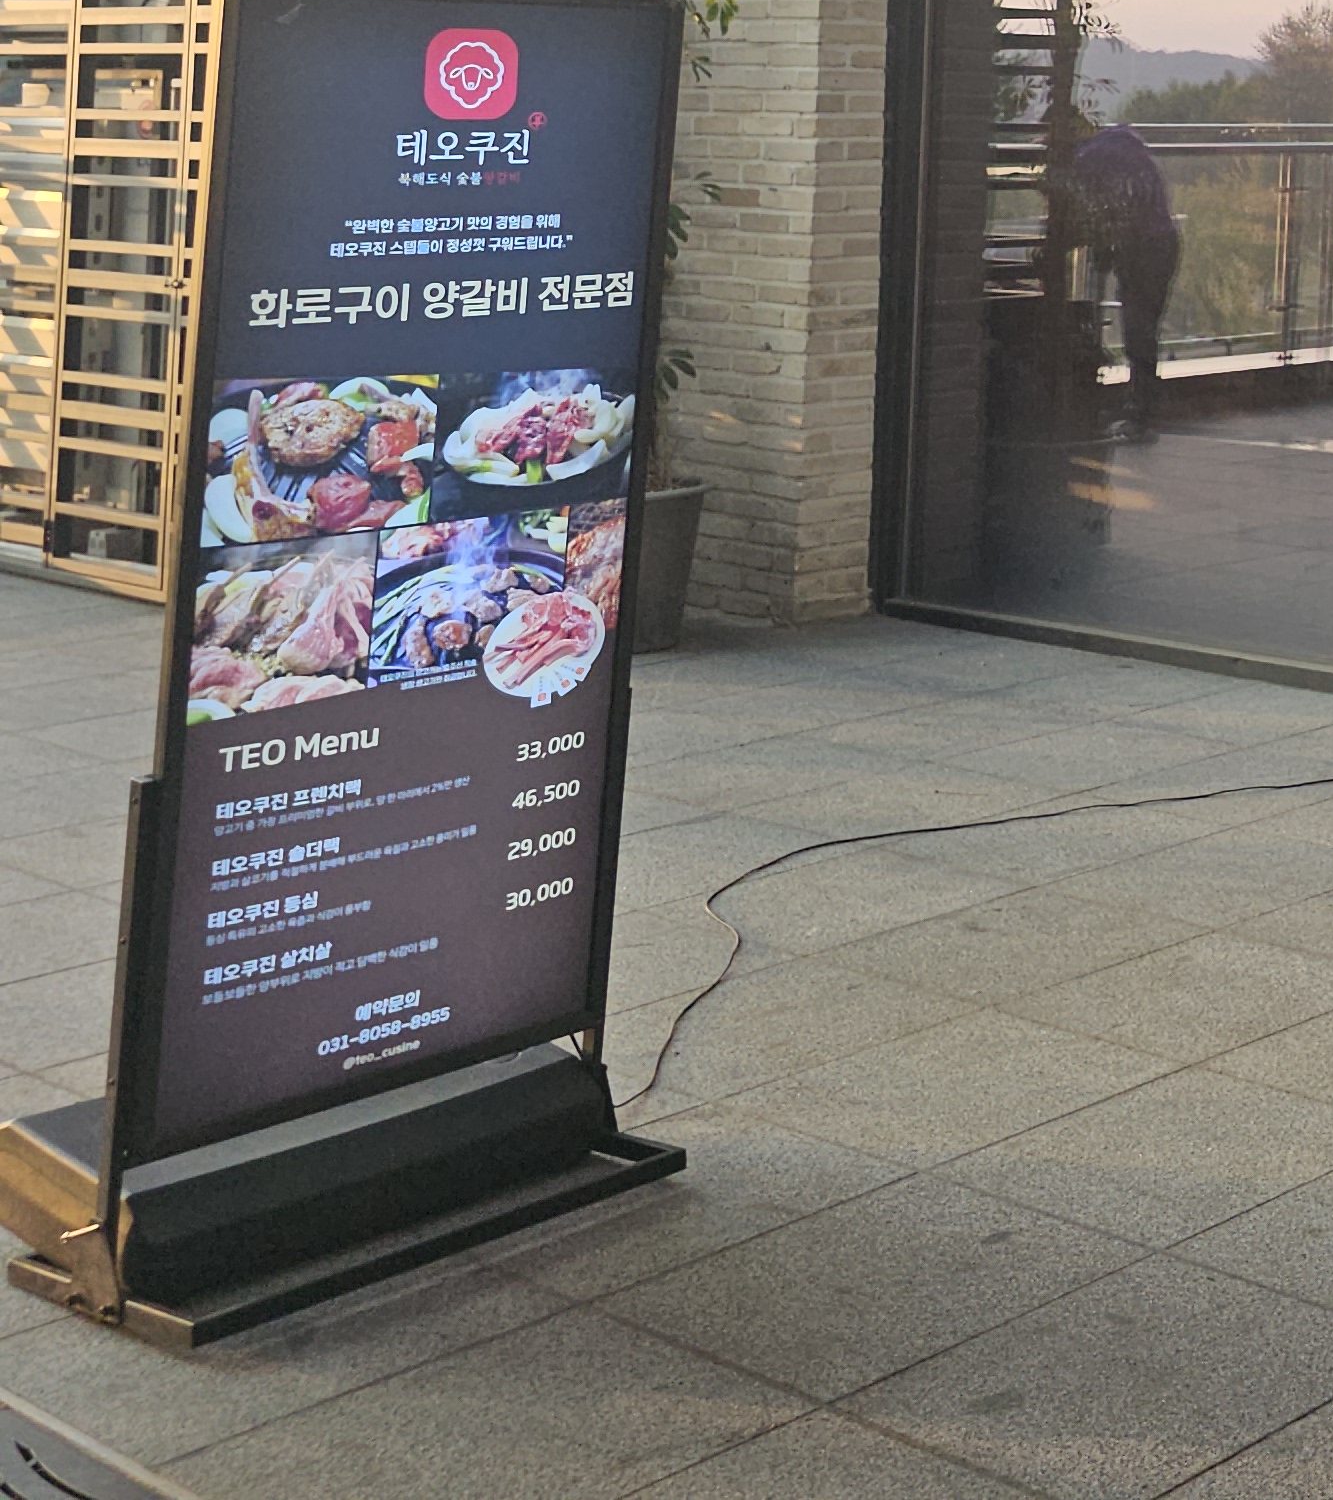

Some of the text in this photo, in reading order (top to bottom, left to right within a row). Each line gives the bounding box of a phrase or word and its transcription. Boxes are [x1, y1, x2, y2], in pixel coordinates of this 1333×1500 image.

[396, 128, 530, 166] 테오쿠진
[467, 215, 492, 230] 맛의
[536, 213, 561, 229] 위해
[330, 241, 386, 258] 테오쿠진
[446, 237, 485, 253] 정성껏
[248, 271, 634, 328] 화로구이 양갈비 전문점
[218, 727, 380, 773] TEO Menu
[515, 731, 585, 762] 33,000
[215, 792, 289, 820] 테오쿠진
[511, 779, 580, 809] 46,500
[507, 827, 576, 860] 29,000
[211, 847, 284, 877] 테오쿠진
[207, 899, 280, 929] 테오쿠진
[284, 890, 319, 913] 등심
[505, 877, 574, 911] 30,000
[203, 954, 277, 985] 테오쿠진
[280, 940, 333, 969] 살치살
[354, 989, 421, 1021] 예약문의
[317, 1006, 451, 1056] 031-8058-8955
